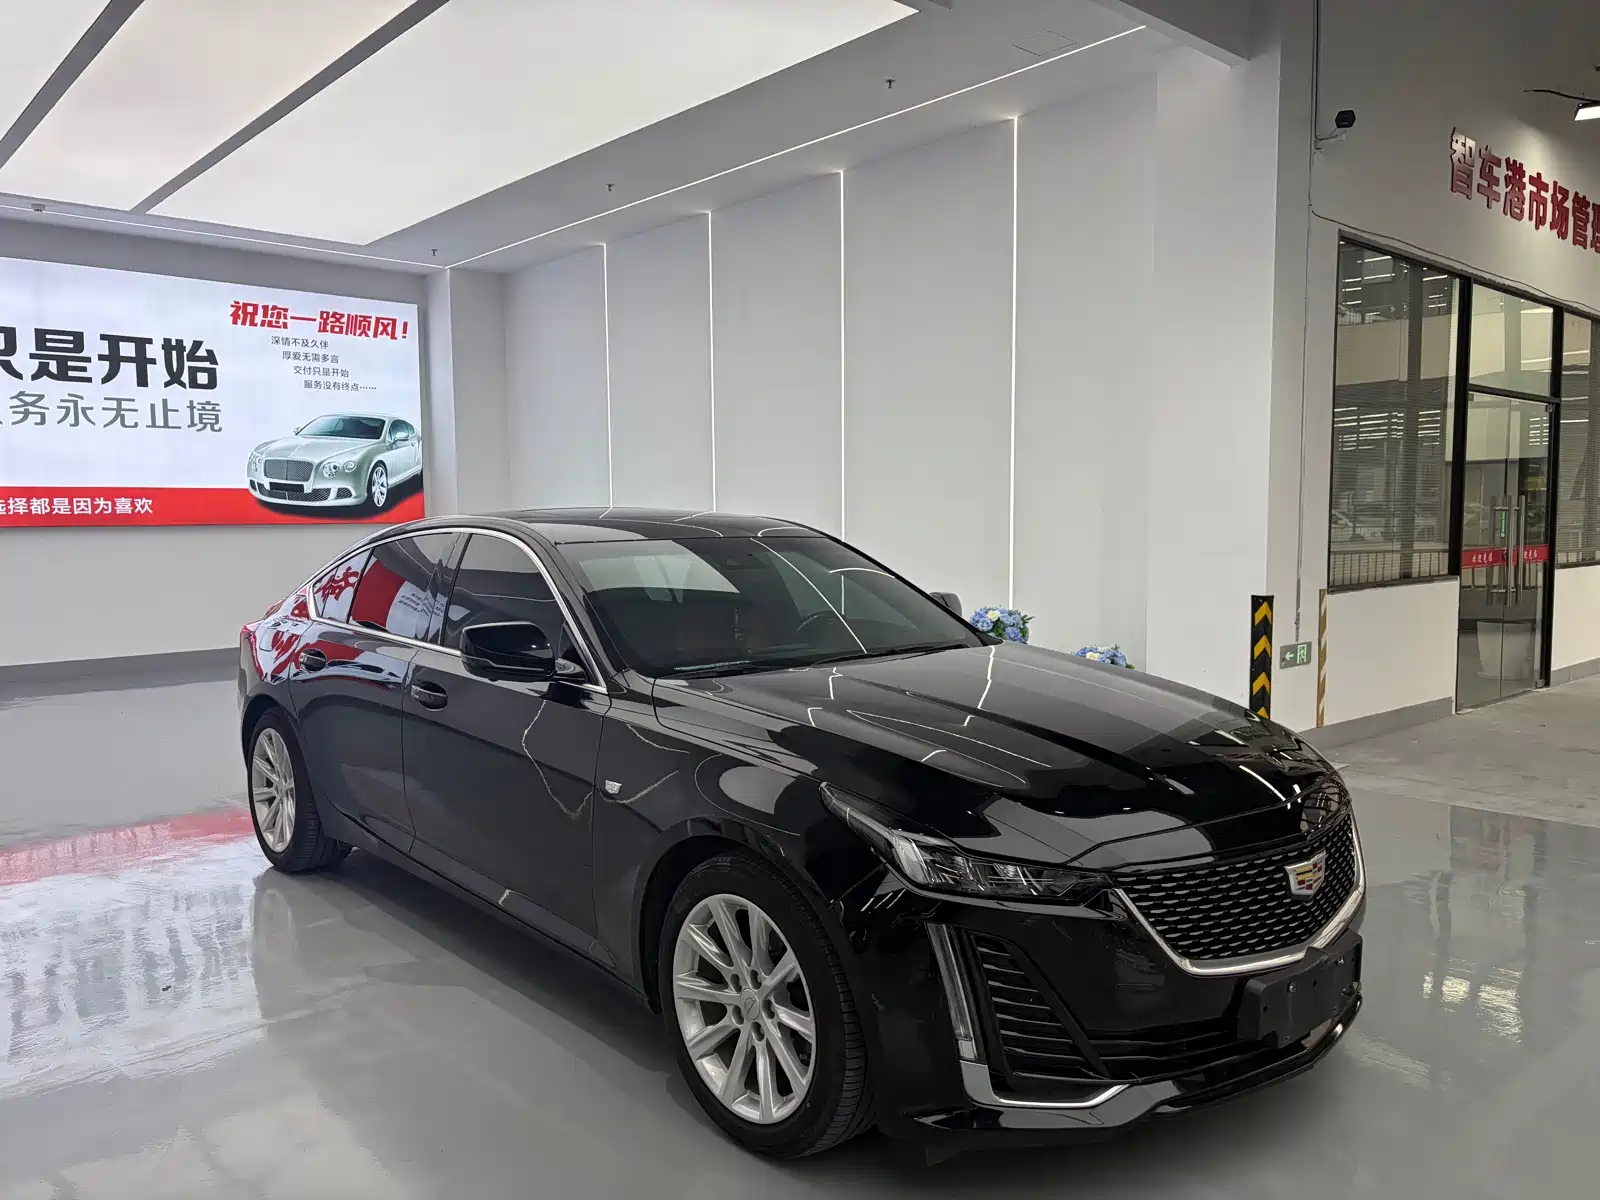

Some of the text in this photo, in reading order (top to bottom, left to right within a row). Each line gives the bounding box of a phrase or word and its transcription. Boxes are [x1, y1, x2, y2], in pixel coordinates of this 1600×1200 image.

[271, 335, 329, 350] 深情不及久伴
[282, 350, 339, 364] 厚爱无需多言
[293, 365, 350, 379] 交付只是开始
[0, 390, 223, 433] 务永无止境
